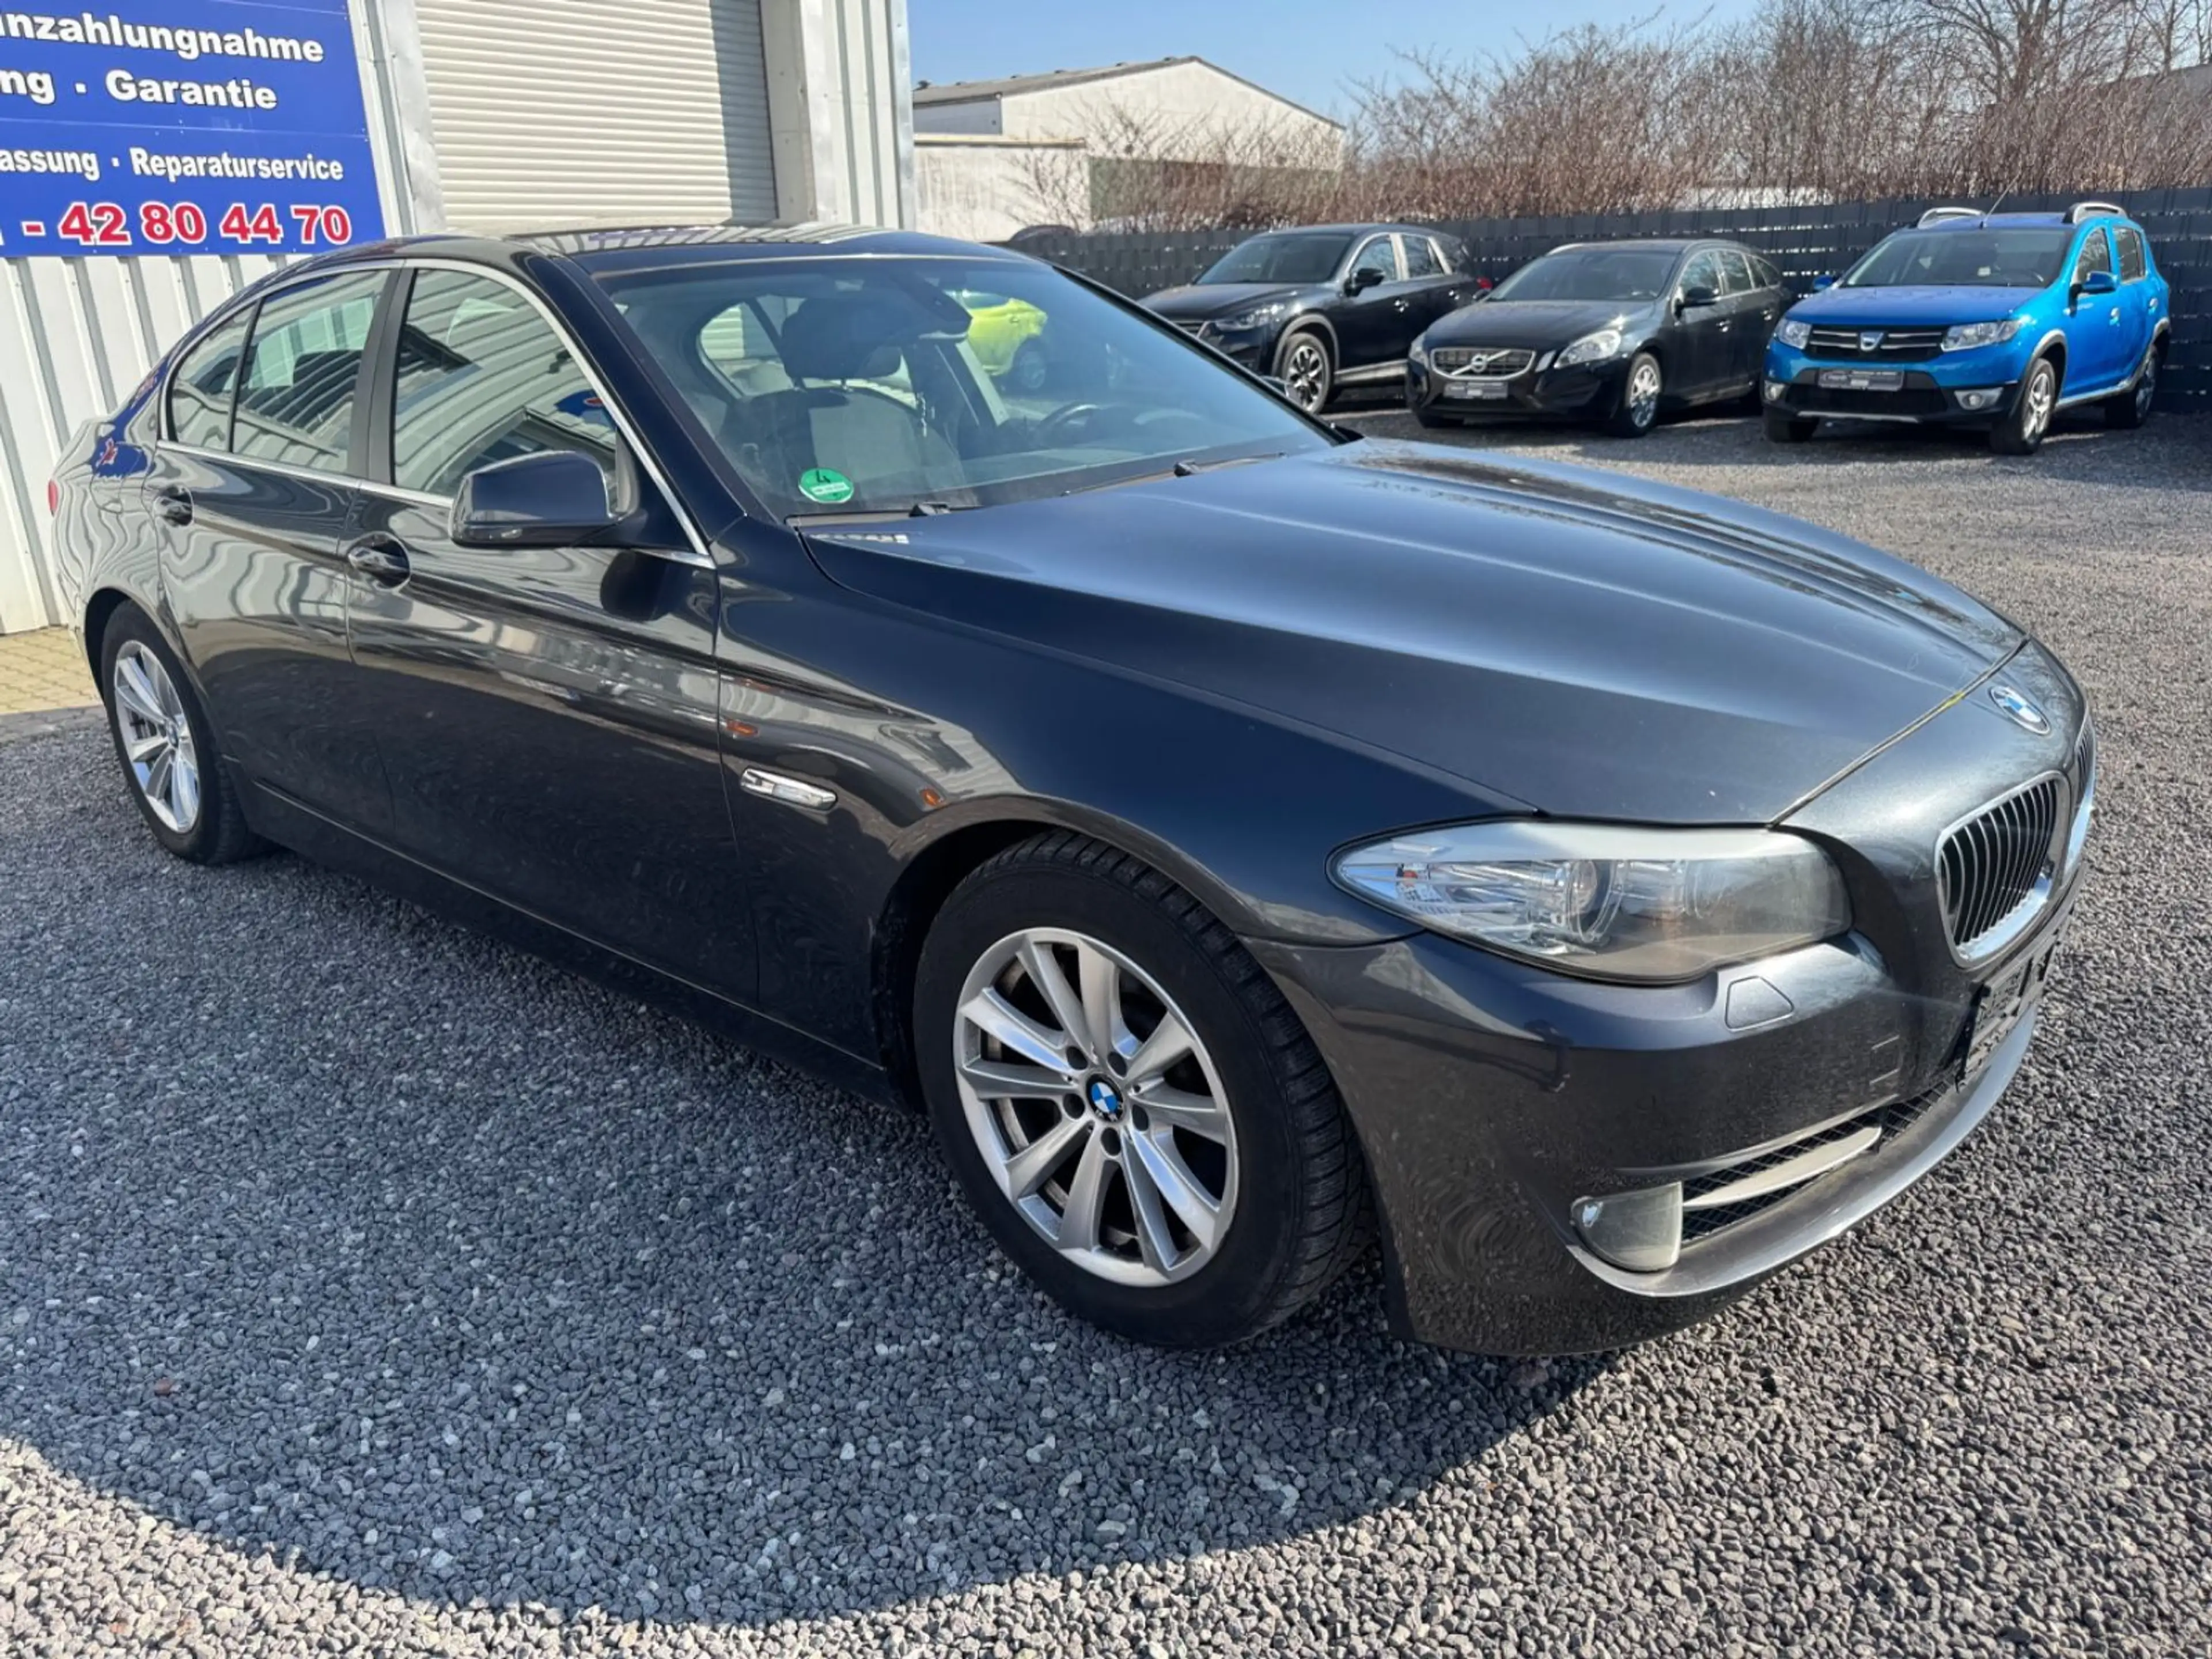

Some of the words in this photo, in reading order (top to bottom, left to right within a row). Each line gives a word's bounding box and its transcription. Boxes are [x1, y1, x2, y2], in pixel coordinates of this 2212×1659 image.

[105, 69, 277, 109] Garantie
[0, 149, 100, 181] assung
[129, 147, 344, 183] Reparaturservice
[57, 201, 132, 246] 42
[139, 200, 207, 244] 80
[218, 202, 284, 244] 44
[289, 204, 353, 245] 70
[815, 469, 831, 483] 4
